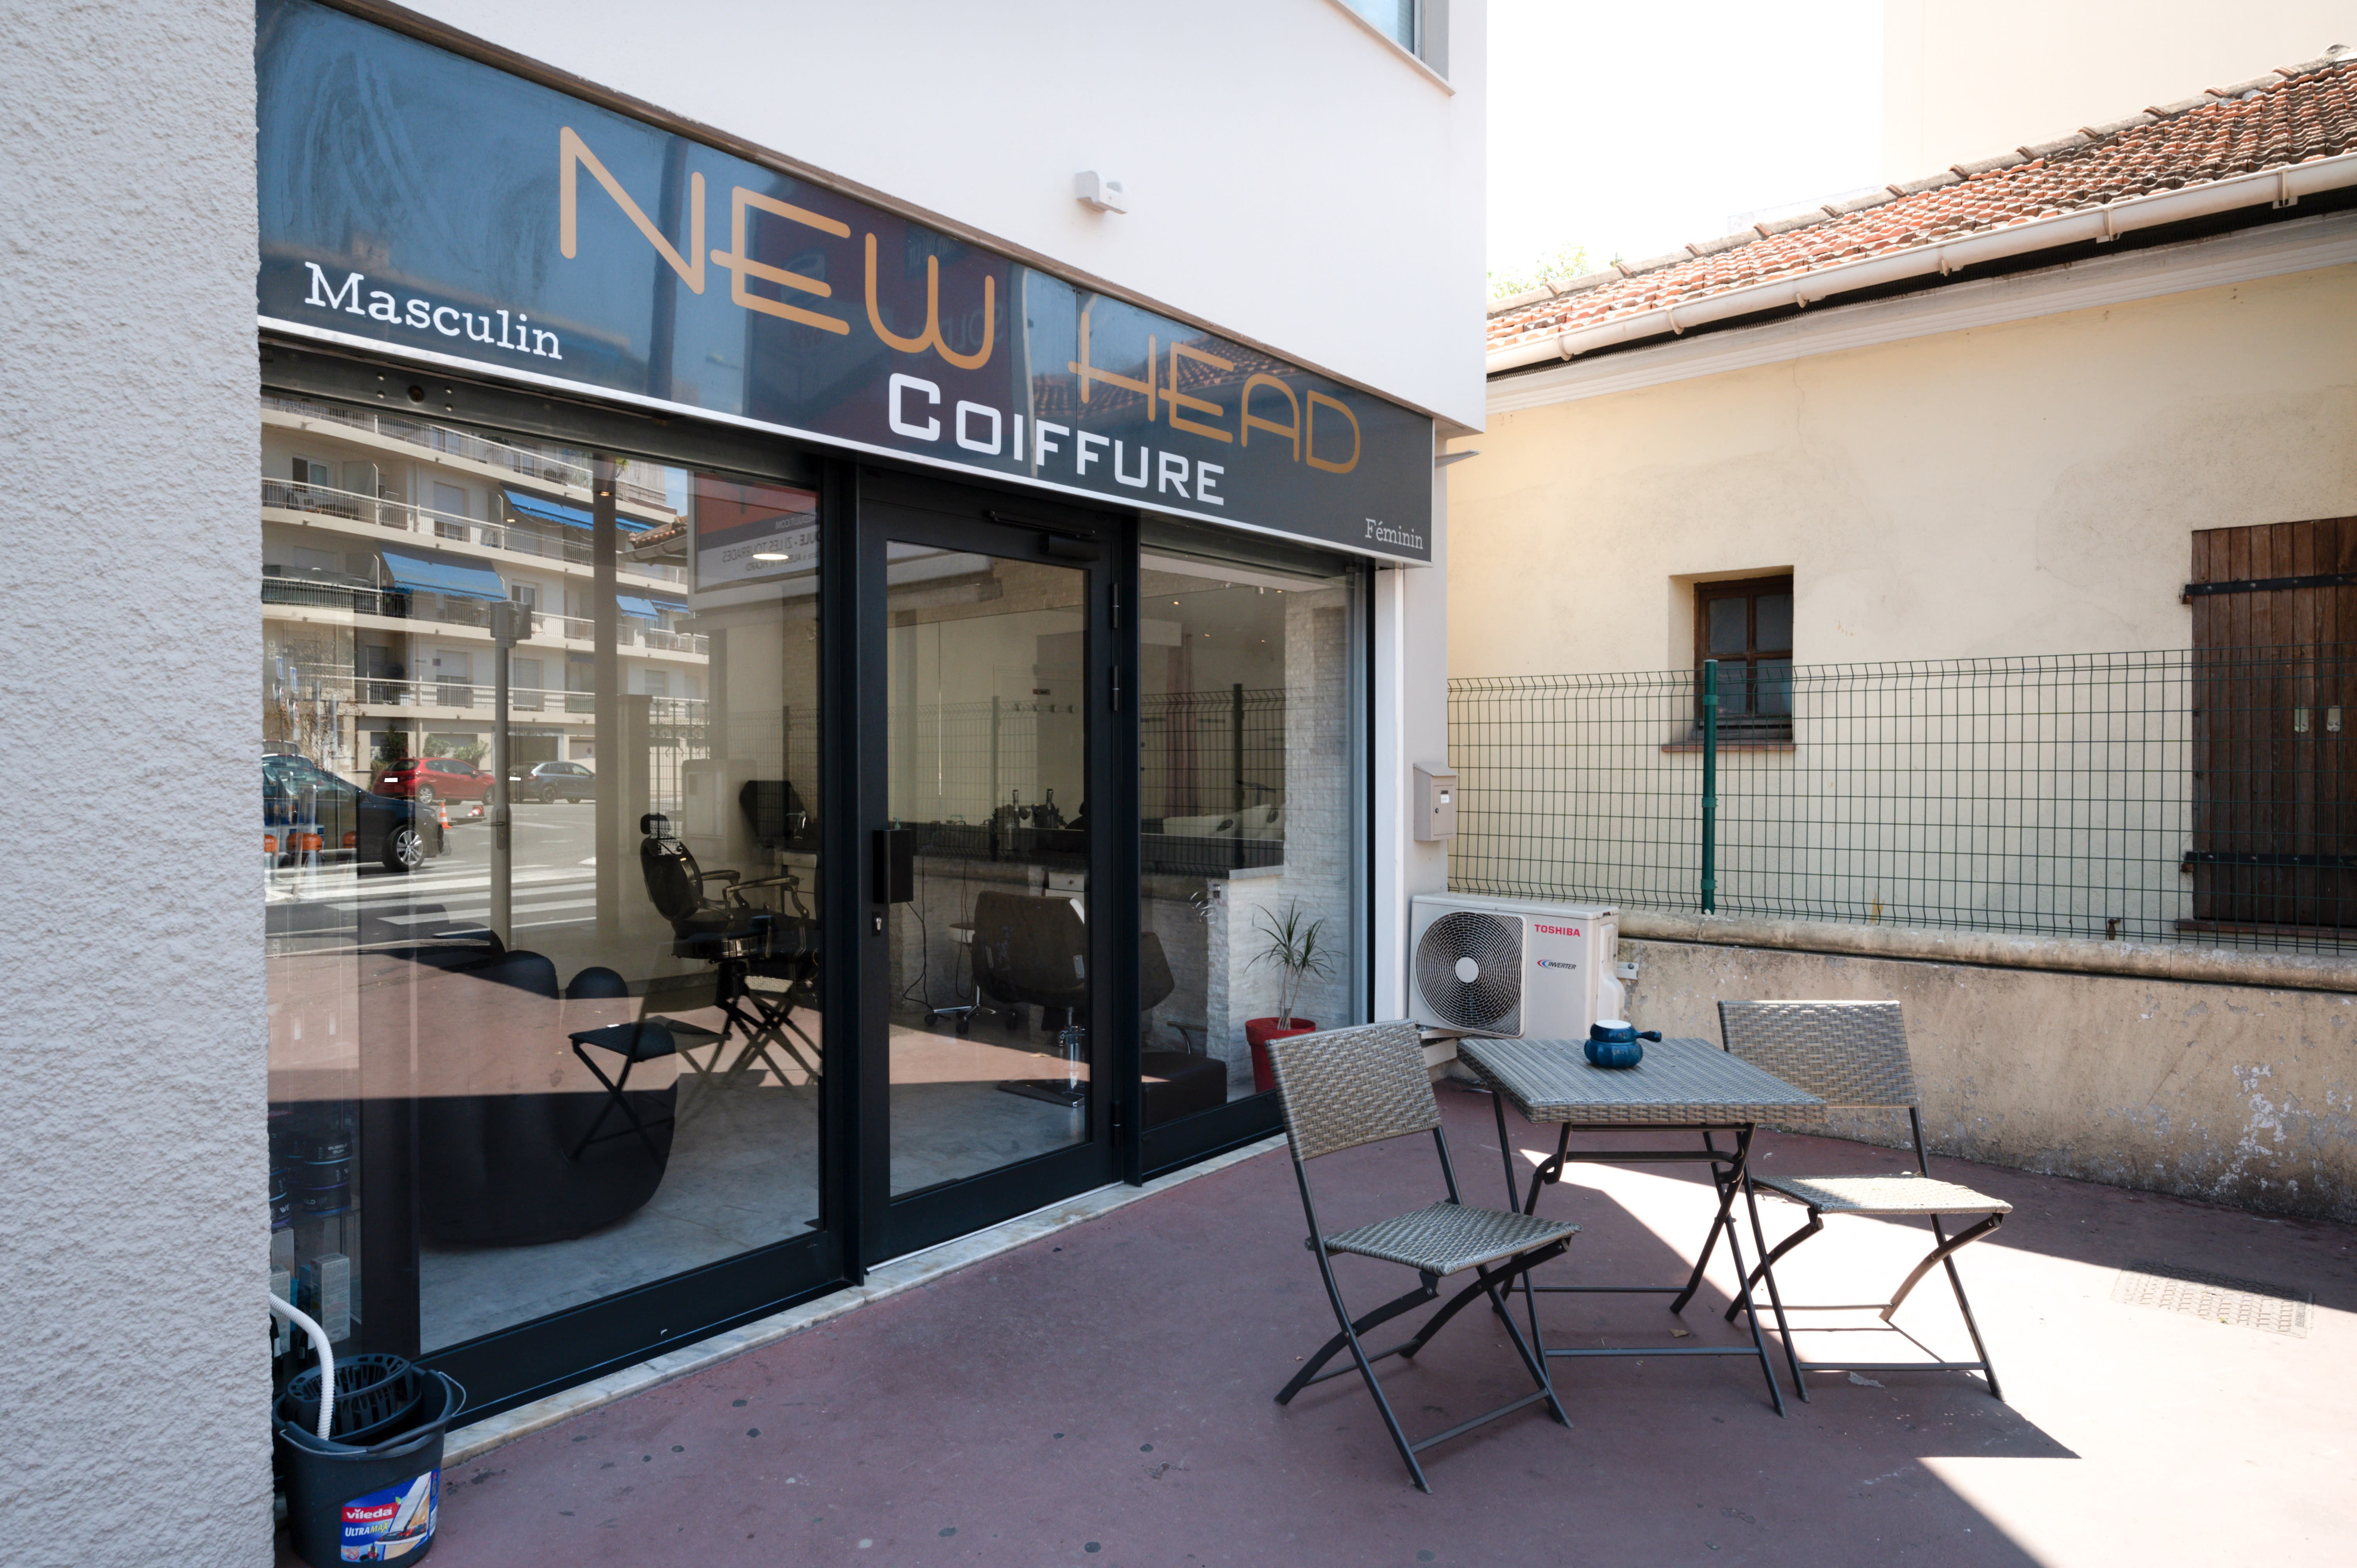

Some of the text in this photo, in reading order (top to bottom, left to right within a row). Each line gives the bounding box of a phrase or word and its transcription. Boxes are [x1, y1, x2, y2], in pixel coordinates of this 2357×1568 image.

[304, 261, 563, 360] Masculin
[560, 126, 1361, 475] NEW HEAD
[889, 372, 1225, 506] COIFFURE
[1364, 517, 1424, 550] Féminin
[1534, 924, 1581, 937] TOSHIBA
[1548, 961, 1576, 970] INVERTER
[346, 1508, 392, 1519] vileda
[345, 1520, 390, 1537] ULTRAMAX
